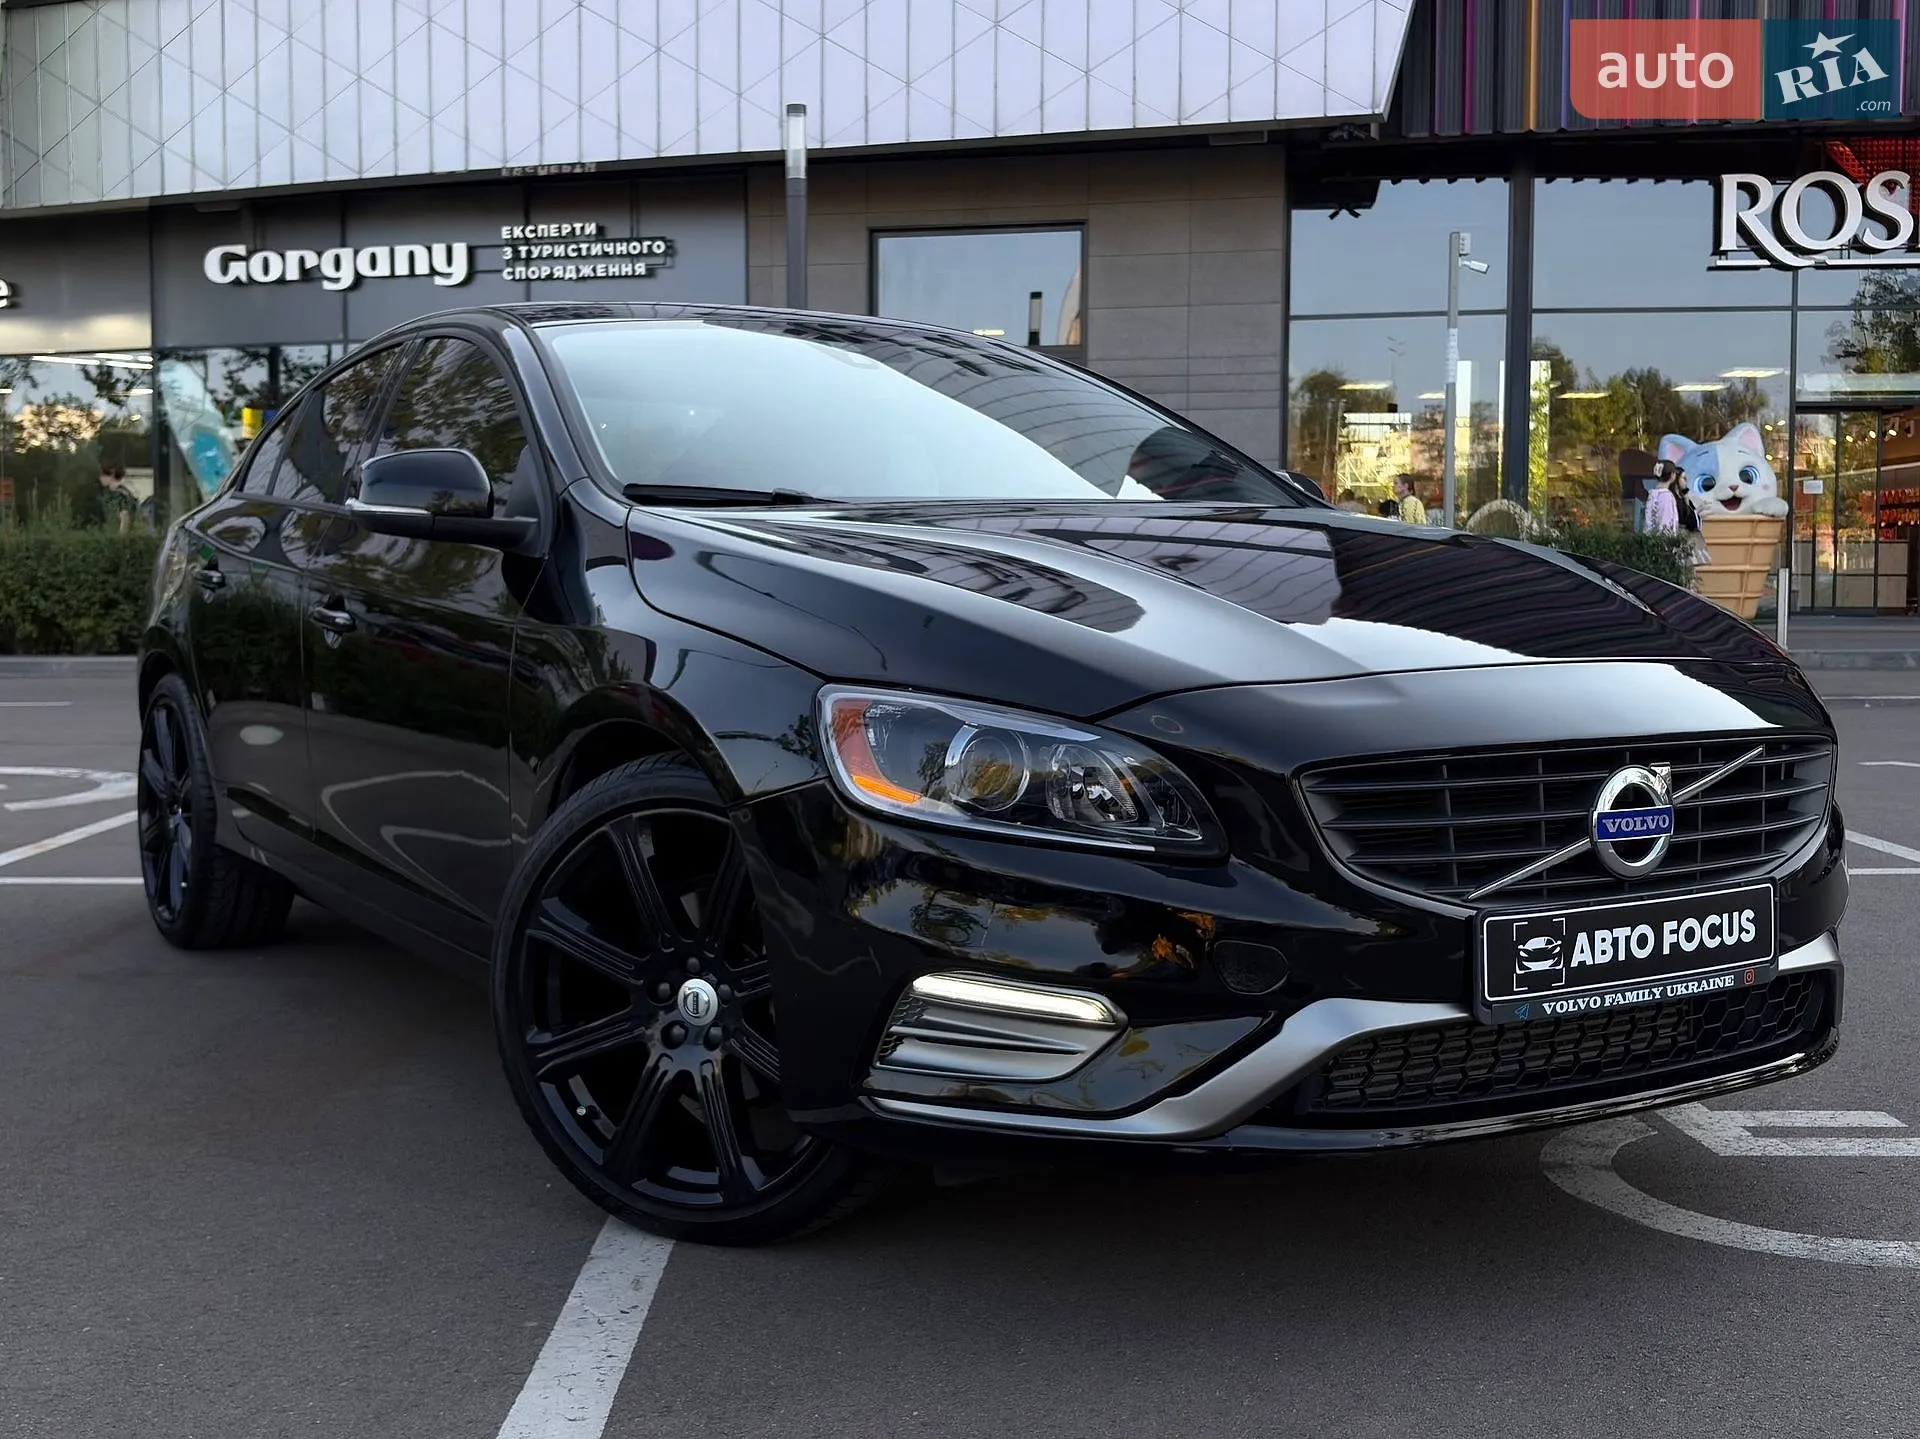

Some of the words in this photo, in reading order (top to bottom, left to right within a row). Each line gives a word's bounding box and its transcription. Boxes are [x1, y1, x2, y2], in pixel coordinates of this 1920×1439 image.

[501, 222, 597, 240] ЕКСПЕРТИ
[1718, 170, 1920, 266] ROS
[518, 240, 666, 259] ТУРИСТИЧНОГО
[204, 242, 469, 291] Gorgany
[502, 262, 647, 281] СПОРЯДЖЕННЯ
[1602, 814, 1670, 833] VOLVO
[1662, 908, 1756, 955] FOCUS
[1542, 996, 1601, 1015] VOLVO
[1603, 984, 1662, 1008] FAMILY
[1666, 974, 1735, 997] UKRAINE
